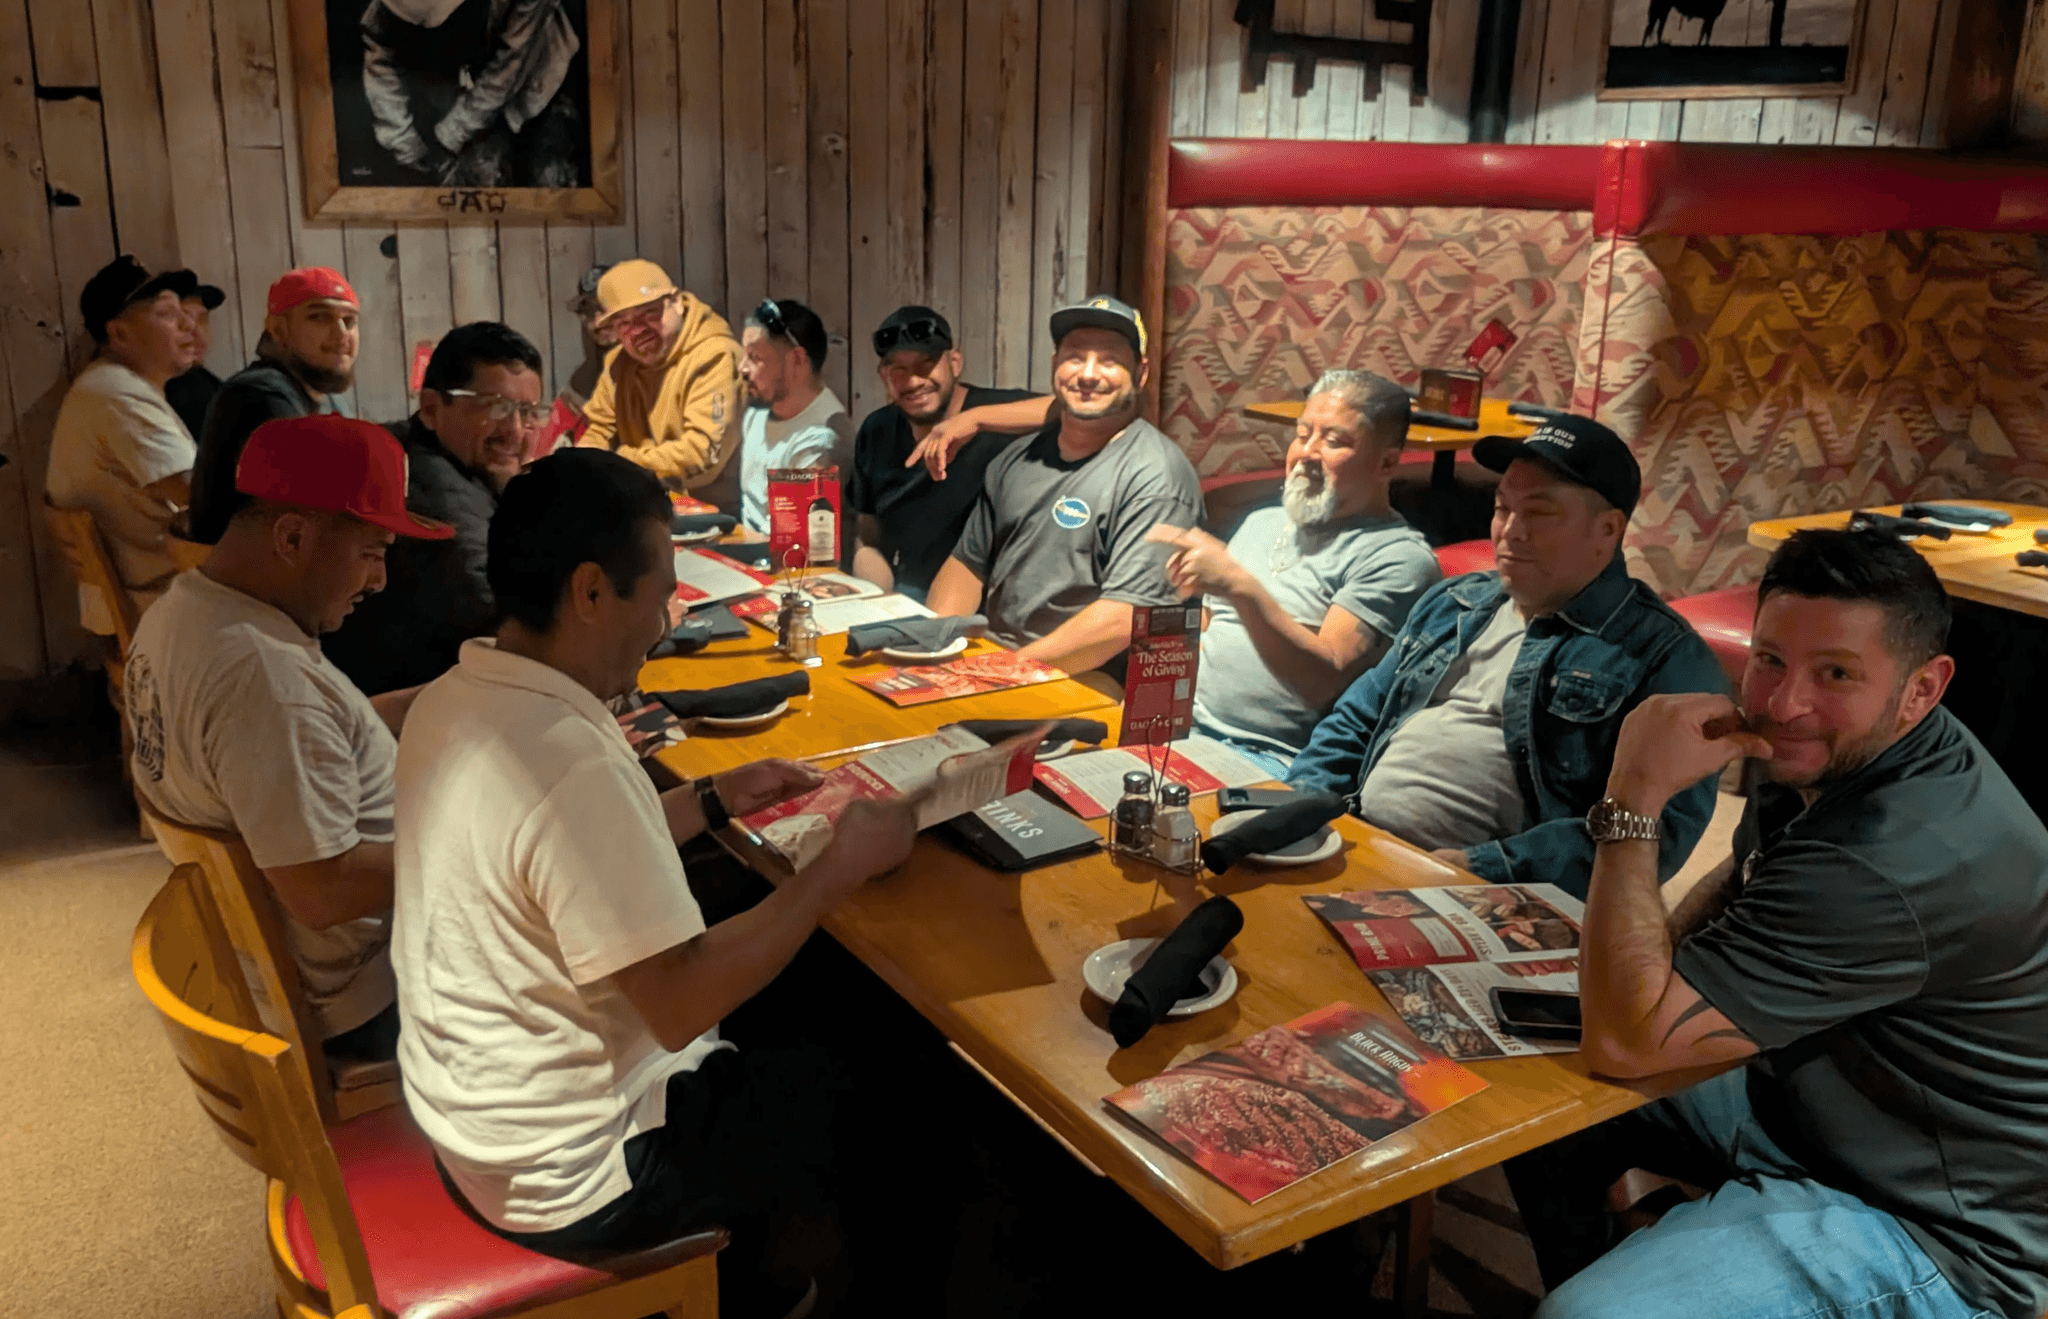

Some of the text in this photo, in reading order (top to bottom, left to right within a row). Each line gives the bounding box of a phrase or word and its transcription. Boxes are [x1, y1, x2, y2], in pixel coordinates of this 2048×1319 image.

[1554, 428, 1576, 441] OUR
[1137, 650, 1193, 664] The Season
[1142, 664, 1187, 678] of Giving
[1349, 1031, 1413, 1072] BLACK ANGUS
